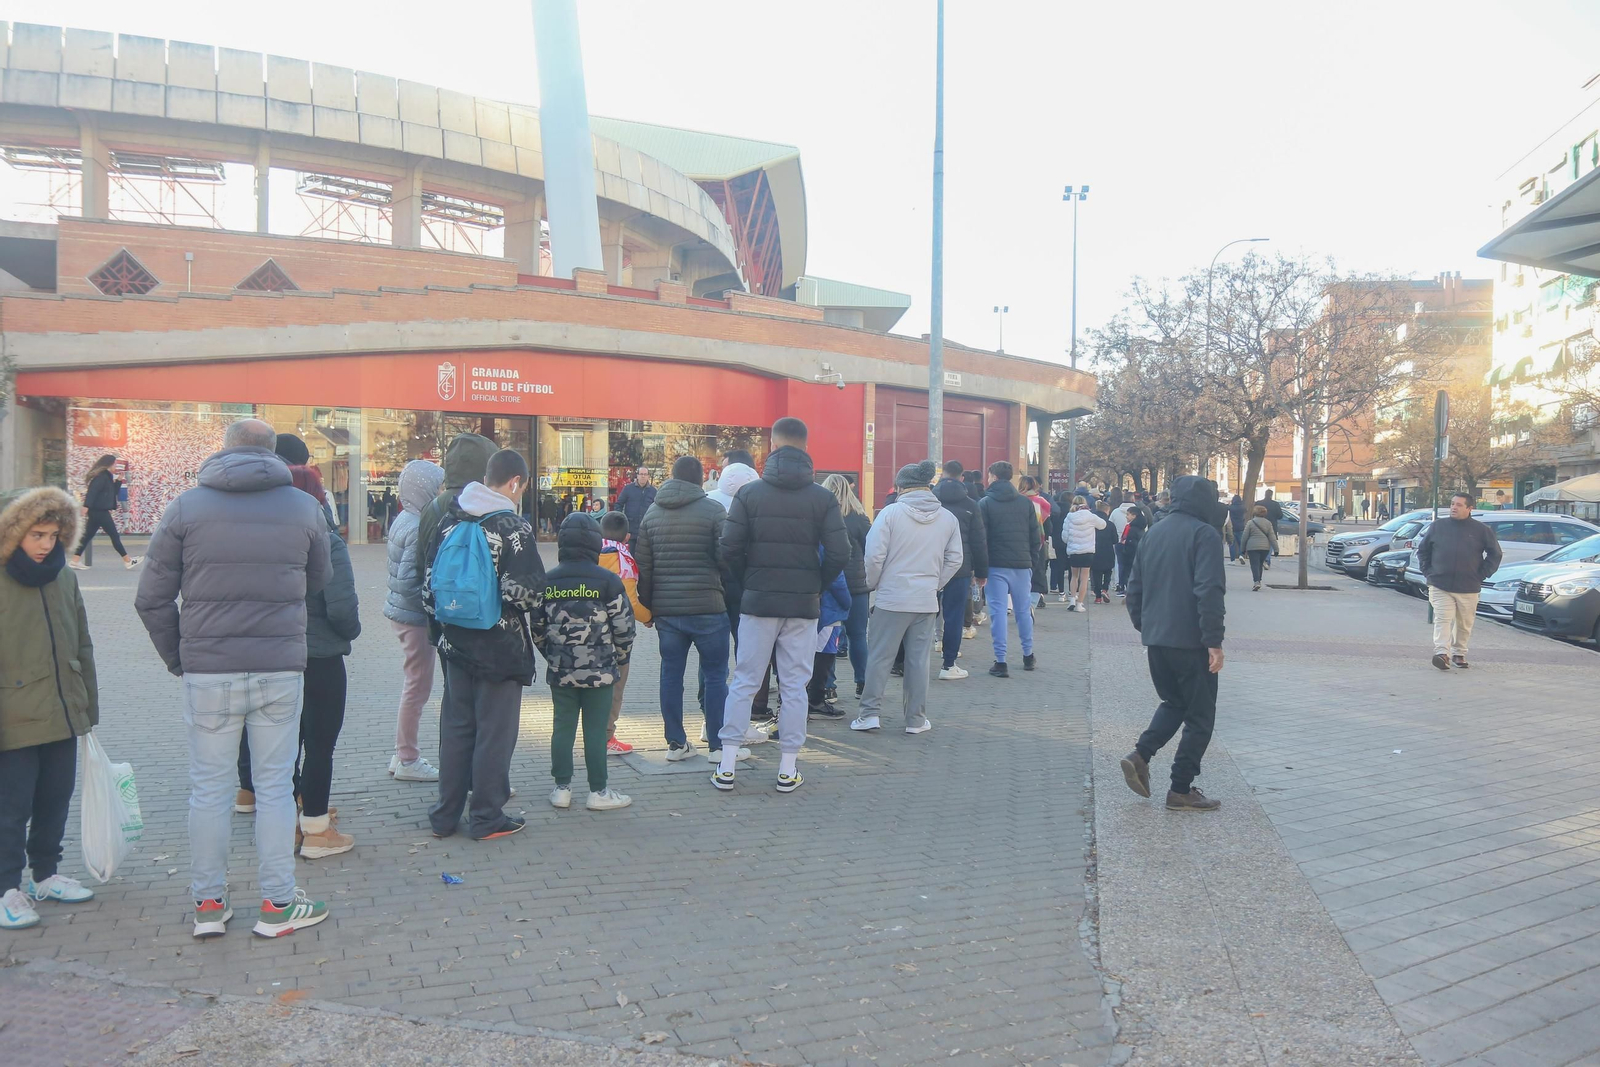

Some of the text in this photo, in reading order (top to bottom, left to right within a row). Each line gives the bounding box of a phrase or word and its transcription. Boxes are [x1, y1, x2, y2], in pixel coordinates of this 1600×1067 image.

[472, 367, 519, 379] GRANADA
[471, 381, 554, 394] CLUB DE FÚTBOL
[471, 394, 521, 403] OFFICIAL STORE
[553, 584, 600, 600] benetton
